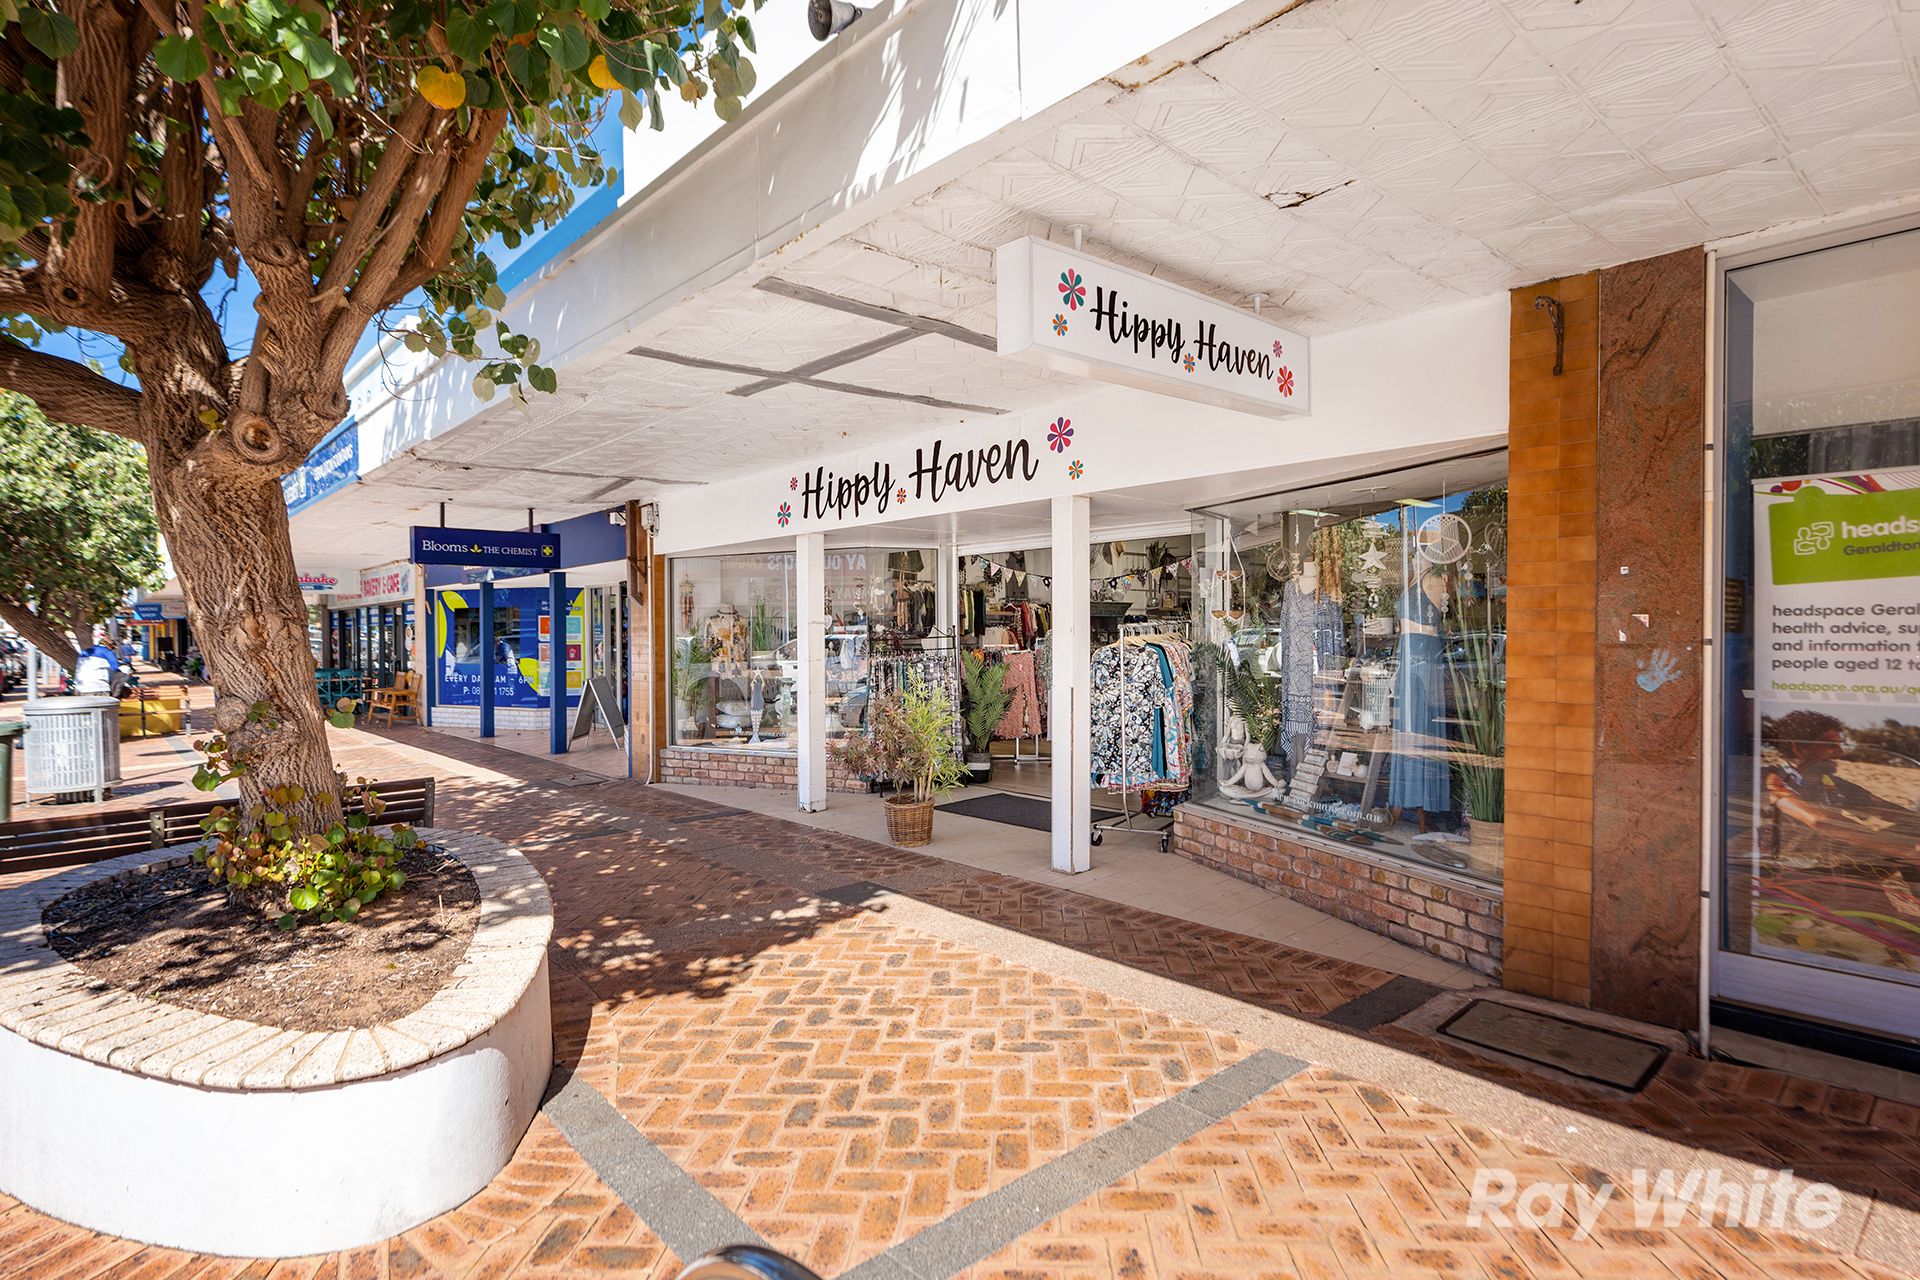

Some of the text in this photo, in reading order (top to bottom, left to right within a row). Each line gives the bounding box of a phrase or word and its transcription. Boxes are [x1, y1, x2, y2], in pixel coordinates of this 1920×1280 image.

[1089, 286, 1274, 380] Hippy Haven
[801, 438, 1039, 519] Hippy Haven
[1841, 515, 1920, 539] heads
[422, 540, 538, 556] Blooms THE CHEMIST
[1771, 604, 1865, 619] headspace
[1772, 621, 1920, 636] health advice, su
[1772, 639, 1803, 651] and
[1808, 639, 1911, 652] information
[1771, 657, 1828, 672] people
[1834, 658, 1879, 673] aged
[1885, 658, 1902, 671] 12
[444, 674, 468, 683] EVERY
[518, 675, 535, 684] 6PM
